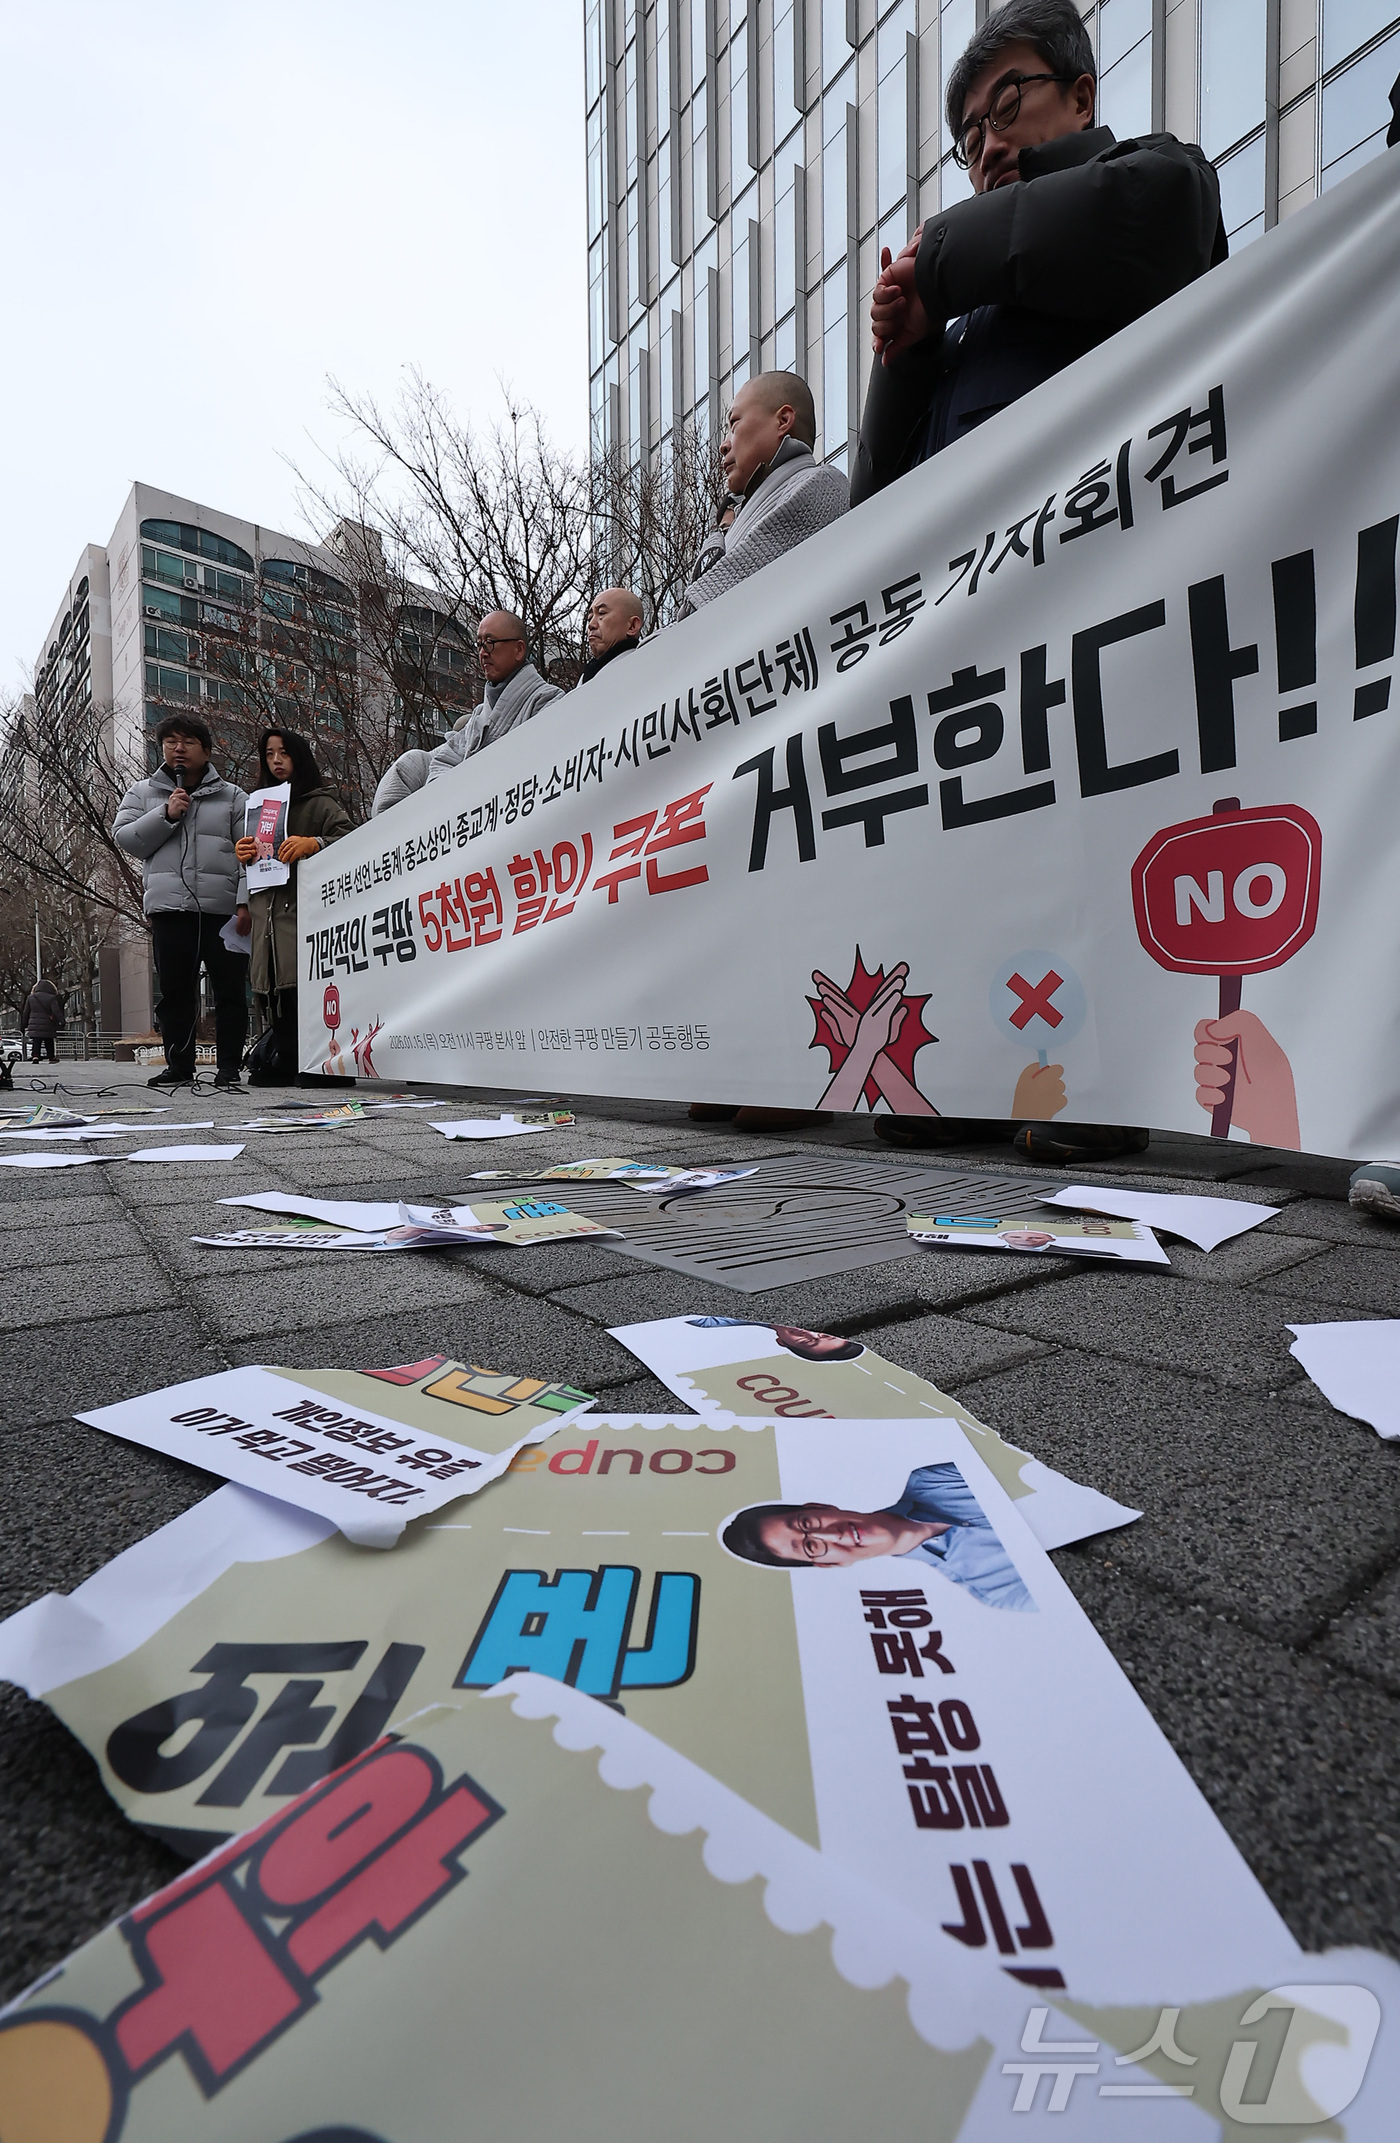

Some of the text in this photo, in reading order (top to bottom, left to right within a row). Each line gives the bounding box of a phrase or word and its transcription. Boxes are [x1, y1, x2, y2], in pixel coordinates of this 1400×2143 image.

[321, 879, 336, 908] 쿠폰
[337, 871, 353, 902] 거부
[353, 861, 372, 894] 선언
[830, 572, 927, 674] 공동
[935, 383, 1230, 606] 기자회견
[306, 513, 1400, 981] 기만적인 쿠팡 5천원 할인 쿠폰 거부한다!!
[1173, 862, 1288, 926] NO
[326, 999, 337, 1016] NO
[538, 1024, 711, 1051] 안전한 쿠팡 만들기 공동행동
[439, 1032, 457, 1050] 오전
[456, 1032, 475, 1050] 11시
[475, 1030, 493, 1050] 쿠팡
[495, 1030, 514, 1050] 본사
[515, 1030, 526, 1050] 앞
[272, 1399, 416, 1455] 개인정보
[736, 1373, 836, 1419] cou
[170, 1407, 427, 1505] 이거 먹고 떨어지
[859, 1588, 956, 1677] 못해
[887, 1694, 1010, 1830] 탈팡
